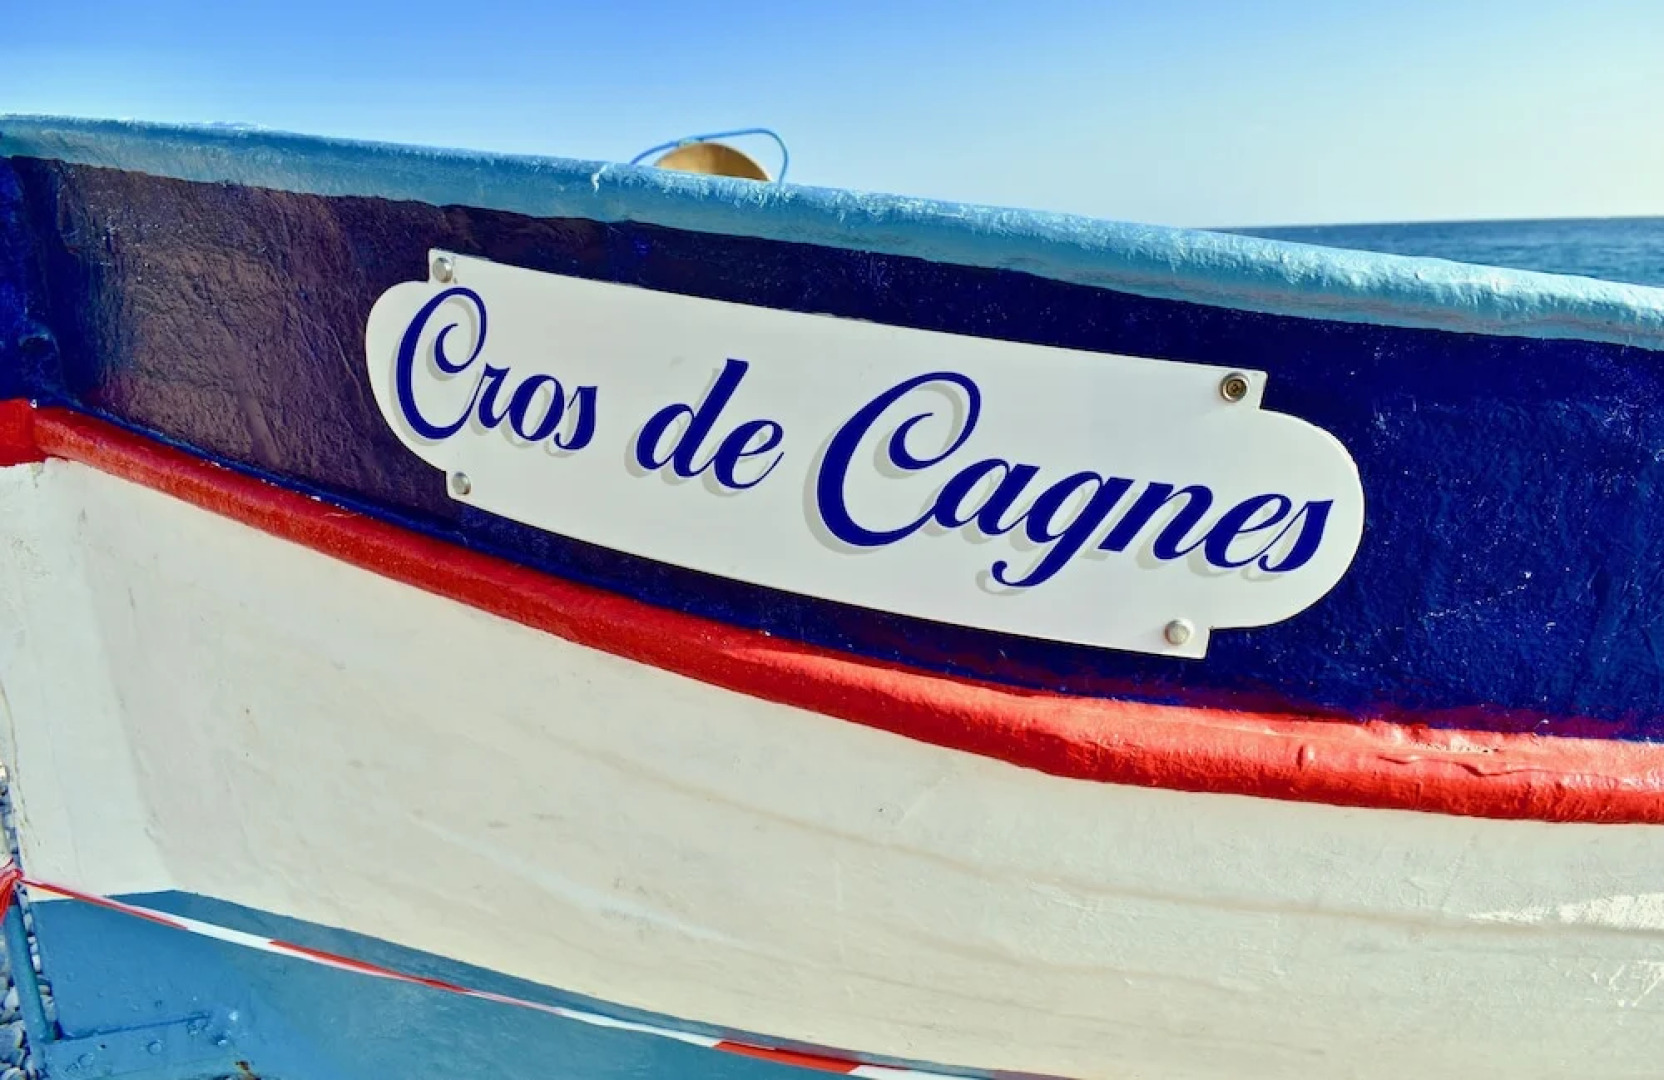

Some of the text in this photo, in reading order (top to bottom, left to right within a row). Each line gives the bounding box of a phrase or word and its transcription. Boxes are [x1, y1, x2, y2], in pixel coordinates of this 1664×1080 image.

[395, 287, 1333, 588] Cros de Cagnes
